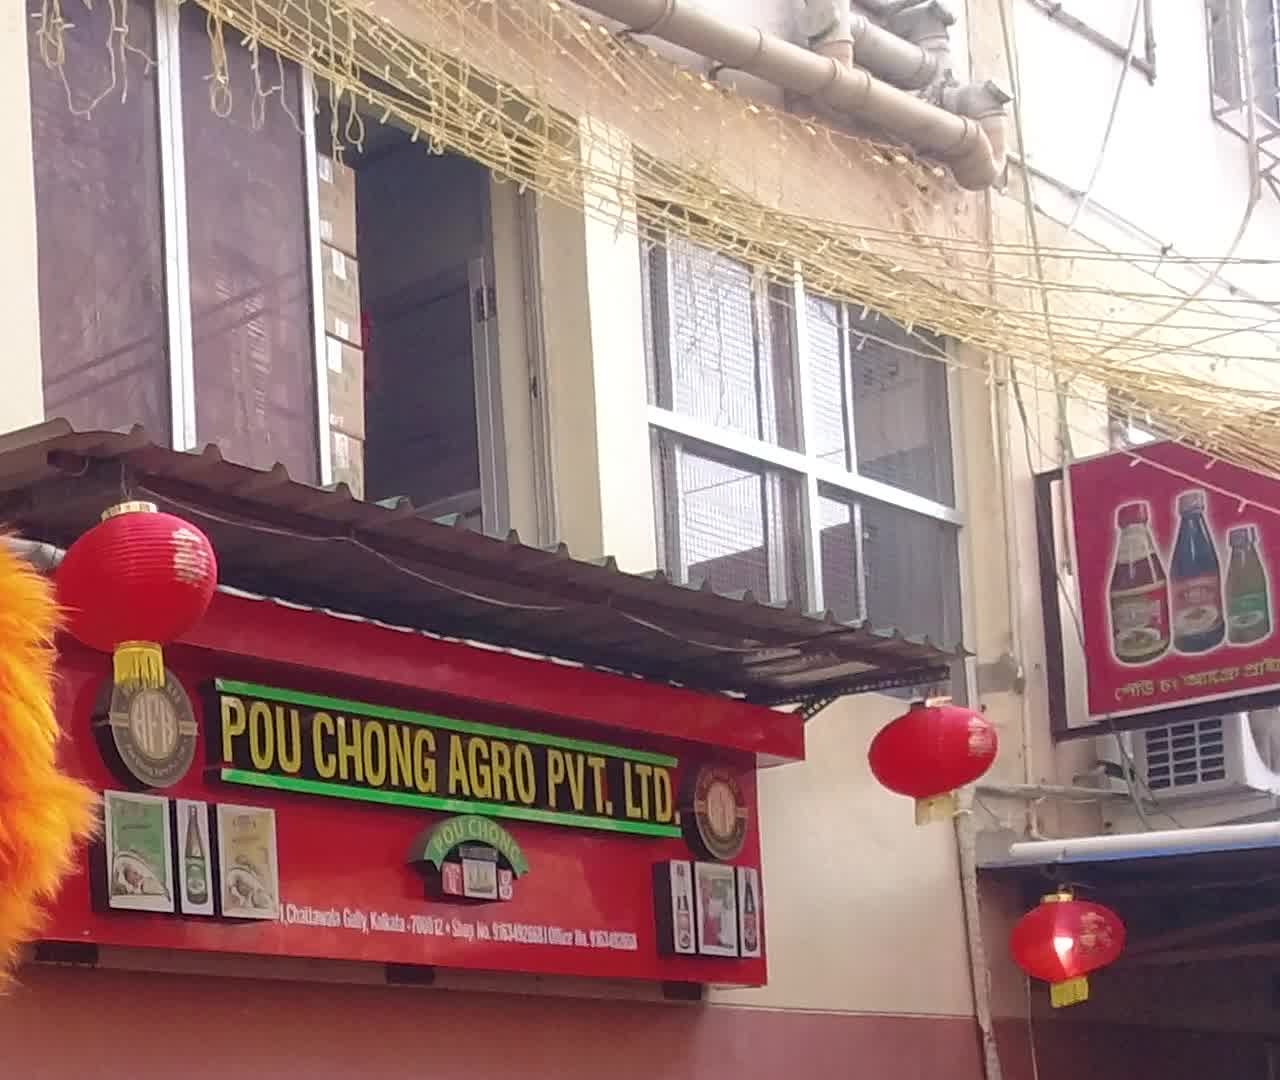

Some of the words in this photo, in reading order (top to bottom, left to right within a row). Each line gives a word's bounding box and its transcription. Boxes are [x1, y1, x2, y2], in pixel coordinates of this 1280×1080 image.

[221, 695, 302, 774] POU
[312, 711, 436, 793] CHONG
[449, 734, 536, 805] AGRO
[547, 749, 613, 815] PVT.
[623, 761, 681, 825] LTD.
[430, 821, 466, 854] POU
[467, 819, 522, 864] CHONG
